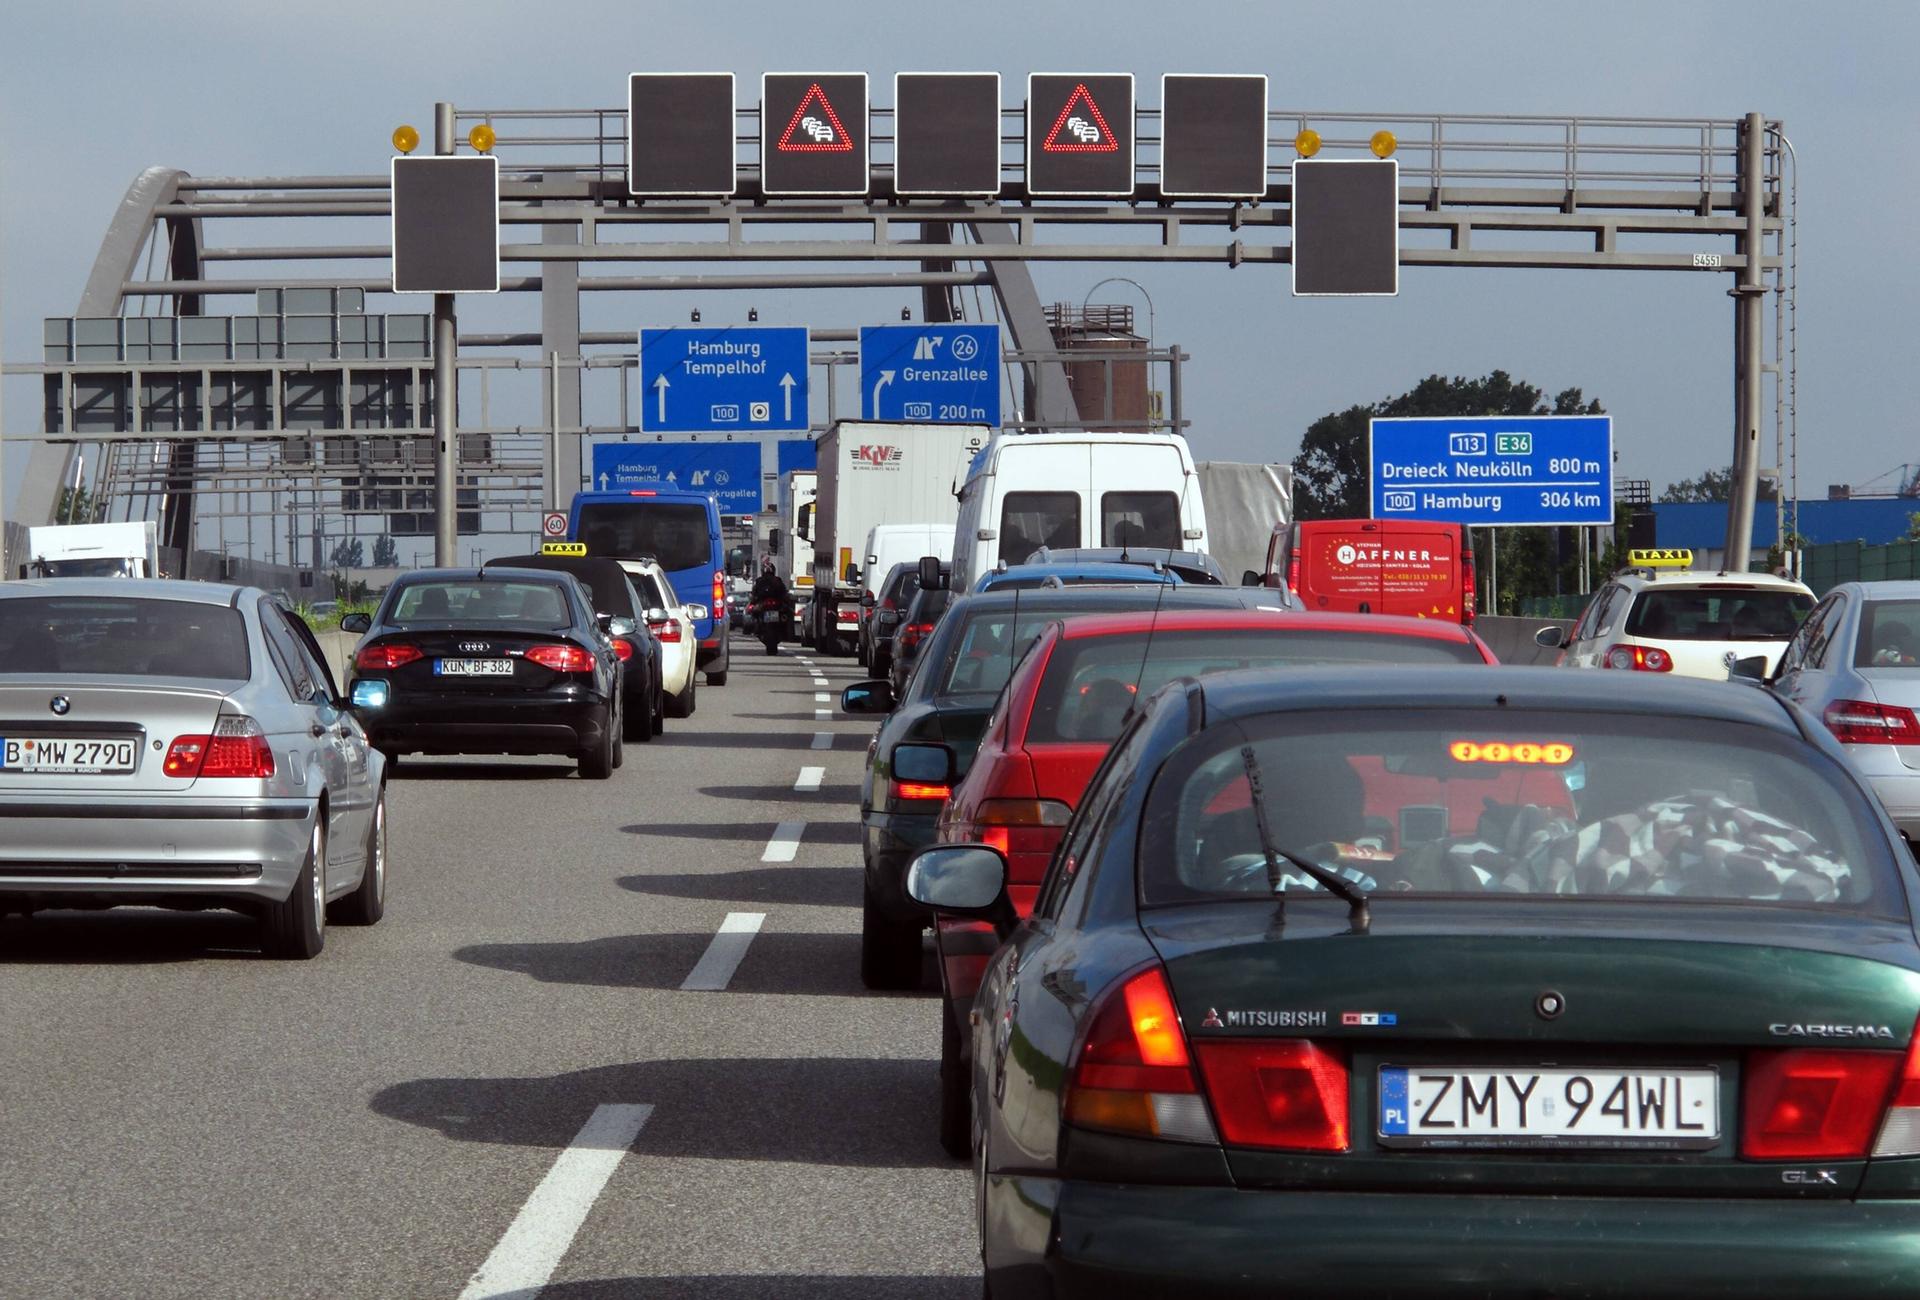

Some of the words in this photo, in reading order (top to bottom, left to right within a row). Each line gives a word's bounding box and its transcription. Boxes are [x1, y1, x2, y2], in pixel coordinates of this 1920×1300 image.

[688, 341, 761, 358] Hamburg
[956, 340, 974, 355] 26
[683, 360, 767, 378] Tempelhof
[903, 367, 989, 381] Grenzallee
[716, 408, 734, 419] 100
[909, 406, 927, 417] 100
[939, 405, 967, 419] 200
[970, 407, 986, 419] m
[1457, 437, 1478, 452] 113
[1499, 437, 1508, 450] E
[1511, 437, 1528, 450] 36
[617, 464, 657, 473] Hamburg
[1382, 462, 1448, 478] Dreieck
[1456, 460, 1532, 477] Neukölln
[1550, 458, 1581, 474] 800
[1584, 461, 1600, 474] m
[1389, 495, 1409, 507] 100
[1423, 493, 1502, 512] Hamburg
[1540, 492, 1571, 508] 306
[1574, 492, 1601, 507] km
[550, 519, 562, 530] 60
[1341, 550, 1431, 561] HAFFNER
[1639, 550, 1683, 559] TAXI
[490, 660, 512, 673] 382
[6, 742, 20, 763] B
[37, 742, 67, 764] MW
[73, 743, 132, 765] 2790
[1227, 1011, 1327, 1027] MITSUBISHI
[1344, 1013, 1396, 1024] RTL
[1768, 1023, 1895, 1039] CARISMA
[1418, 1075, 1541, 1128] ZMY
[1564, 1075, 1705, 1131] 94WL
[1385, 1109, 1406, 1124] PL
[1781, 1169, 1838, 1185] GLX
